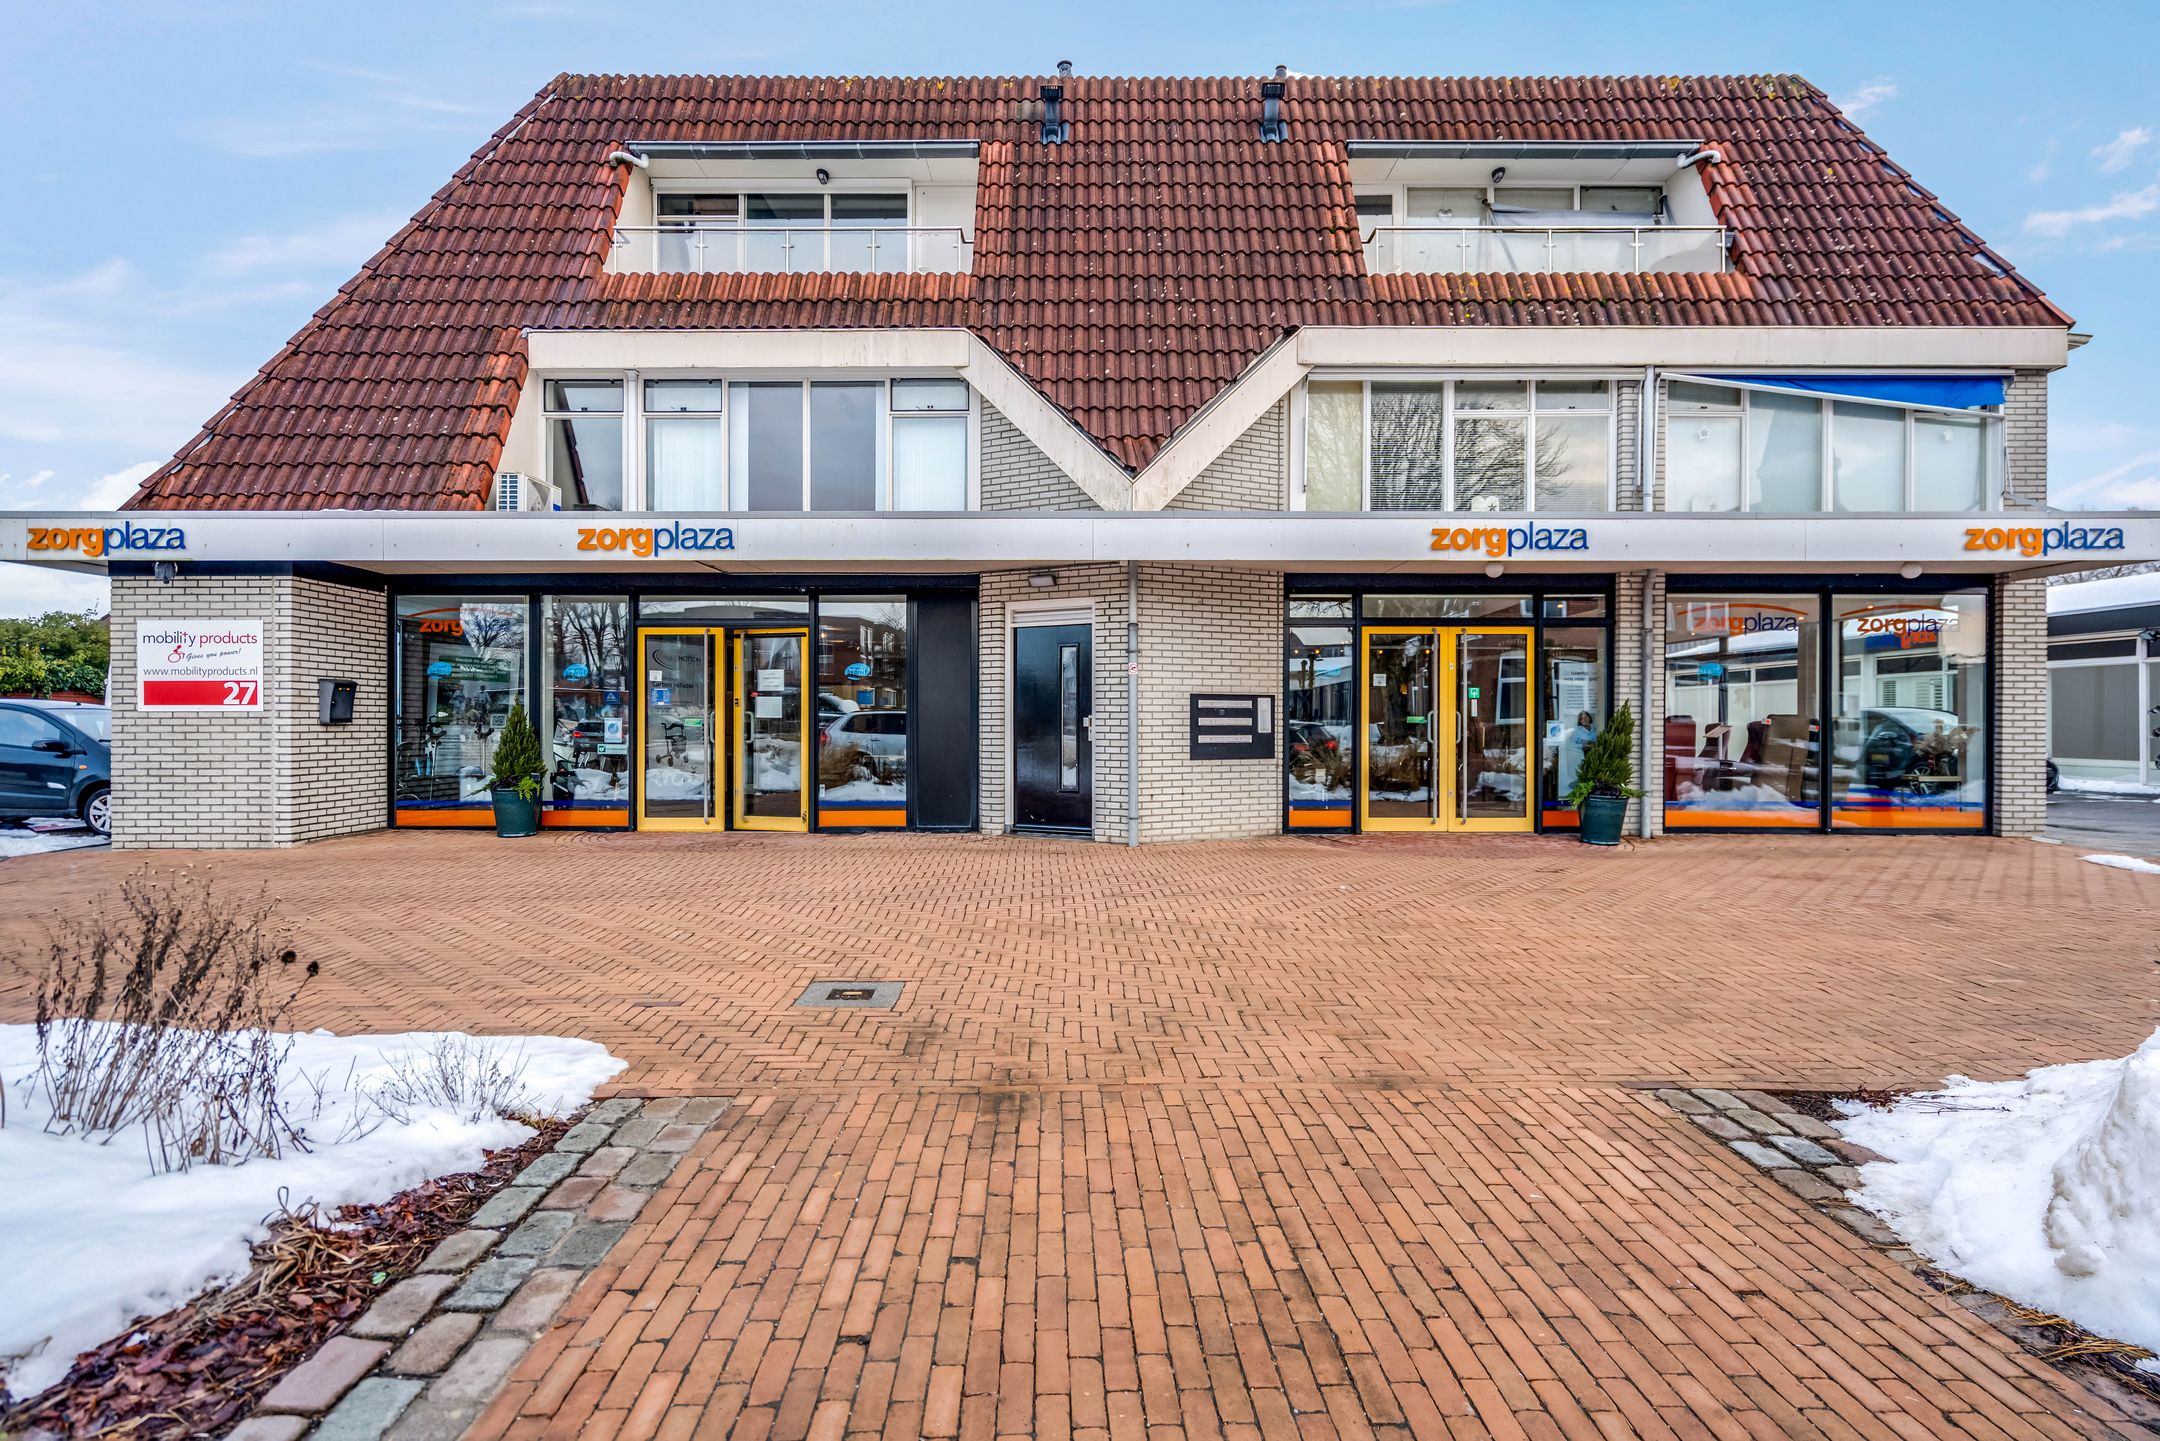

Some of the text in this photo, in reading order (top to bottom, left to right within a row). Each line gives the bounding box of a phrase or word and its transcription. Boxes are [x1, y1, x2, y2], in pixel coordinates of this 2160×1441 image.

[27, 520, 186, 557] zorgplaza
[577, 520, 735, 557] zorgplaza
[1431, 521, 1589, 557] zorgplaza
[1965, 520, 2125, 557] zorgplaza
[142, 631, 258, 648] mobility products
[143, 666, 258, 678] www.mobilityproducts.nl
[222, 681, 257, 705] 27
